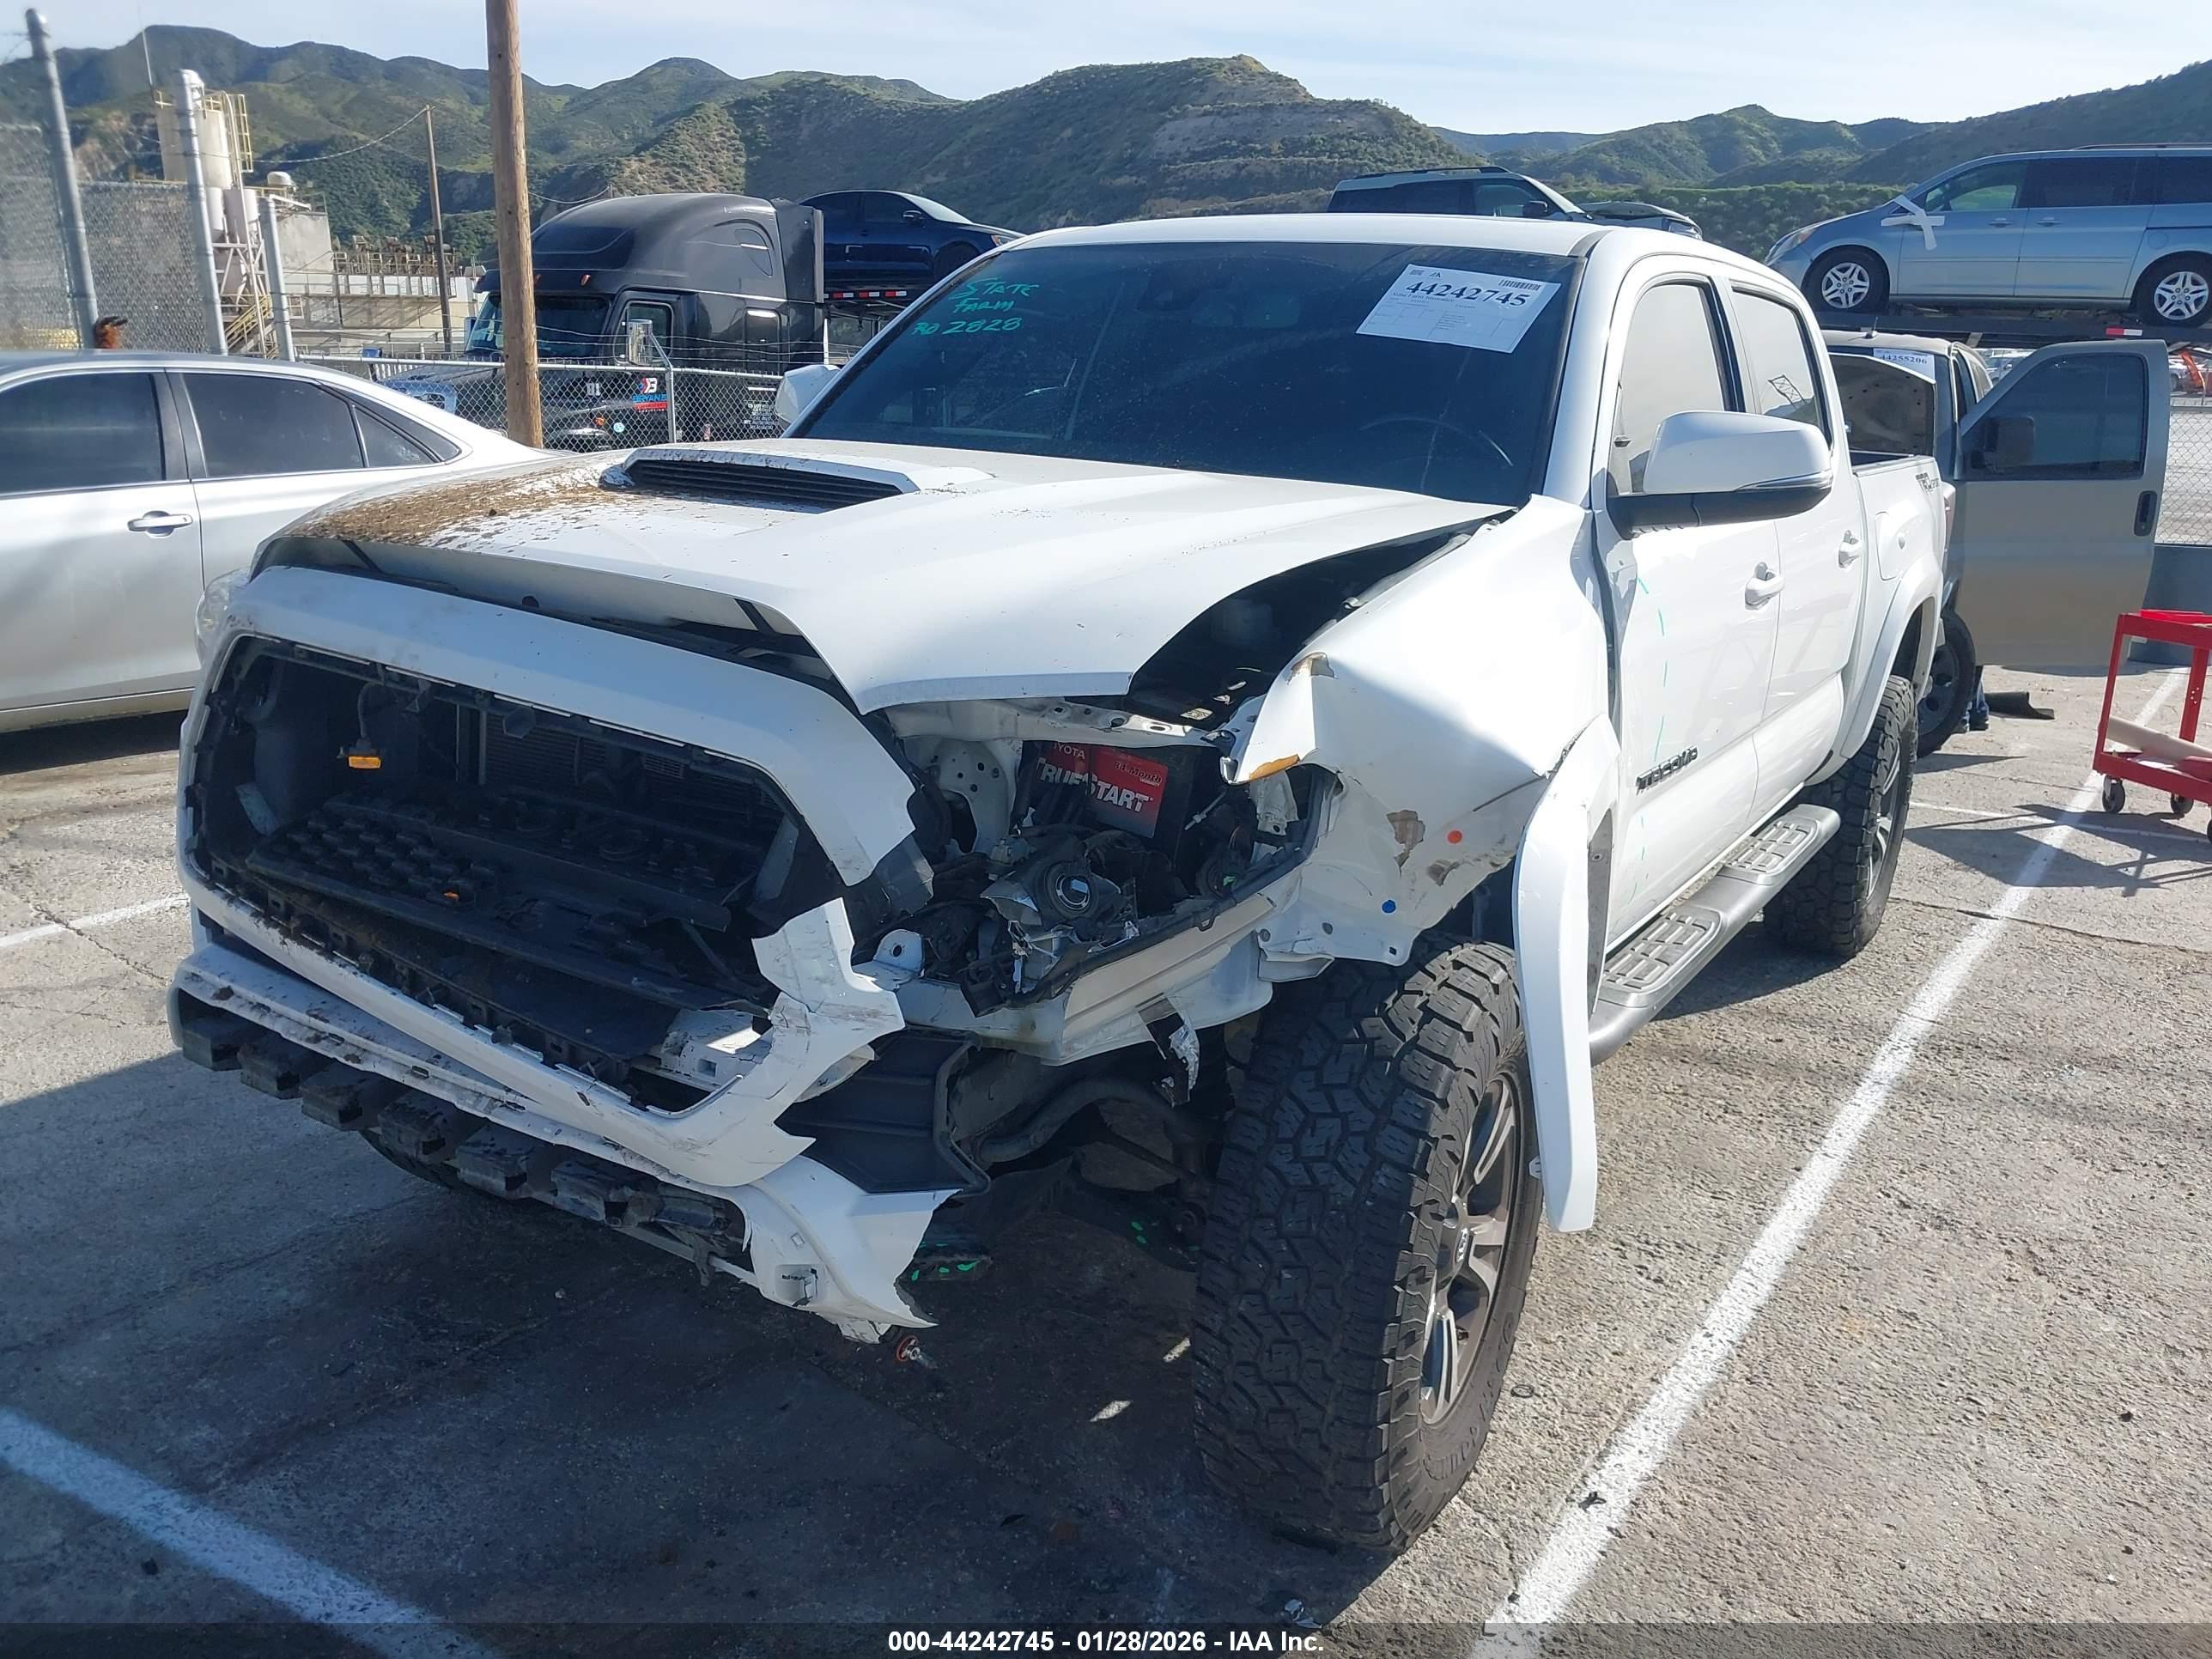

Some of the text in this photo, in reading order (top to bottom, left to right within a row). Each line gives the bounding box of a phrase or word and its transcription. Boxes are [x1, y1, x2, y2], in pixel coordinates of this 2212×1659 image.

[948, 276, 1040, 300] STATE
[1405, 281, 1531, 307] 44242745
[942, 317, 1023, 335] 2828
[1128, 768, 1162, 784] Month
